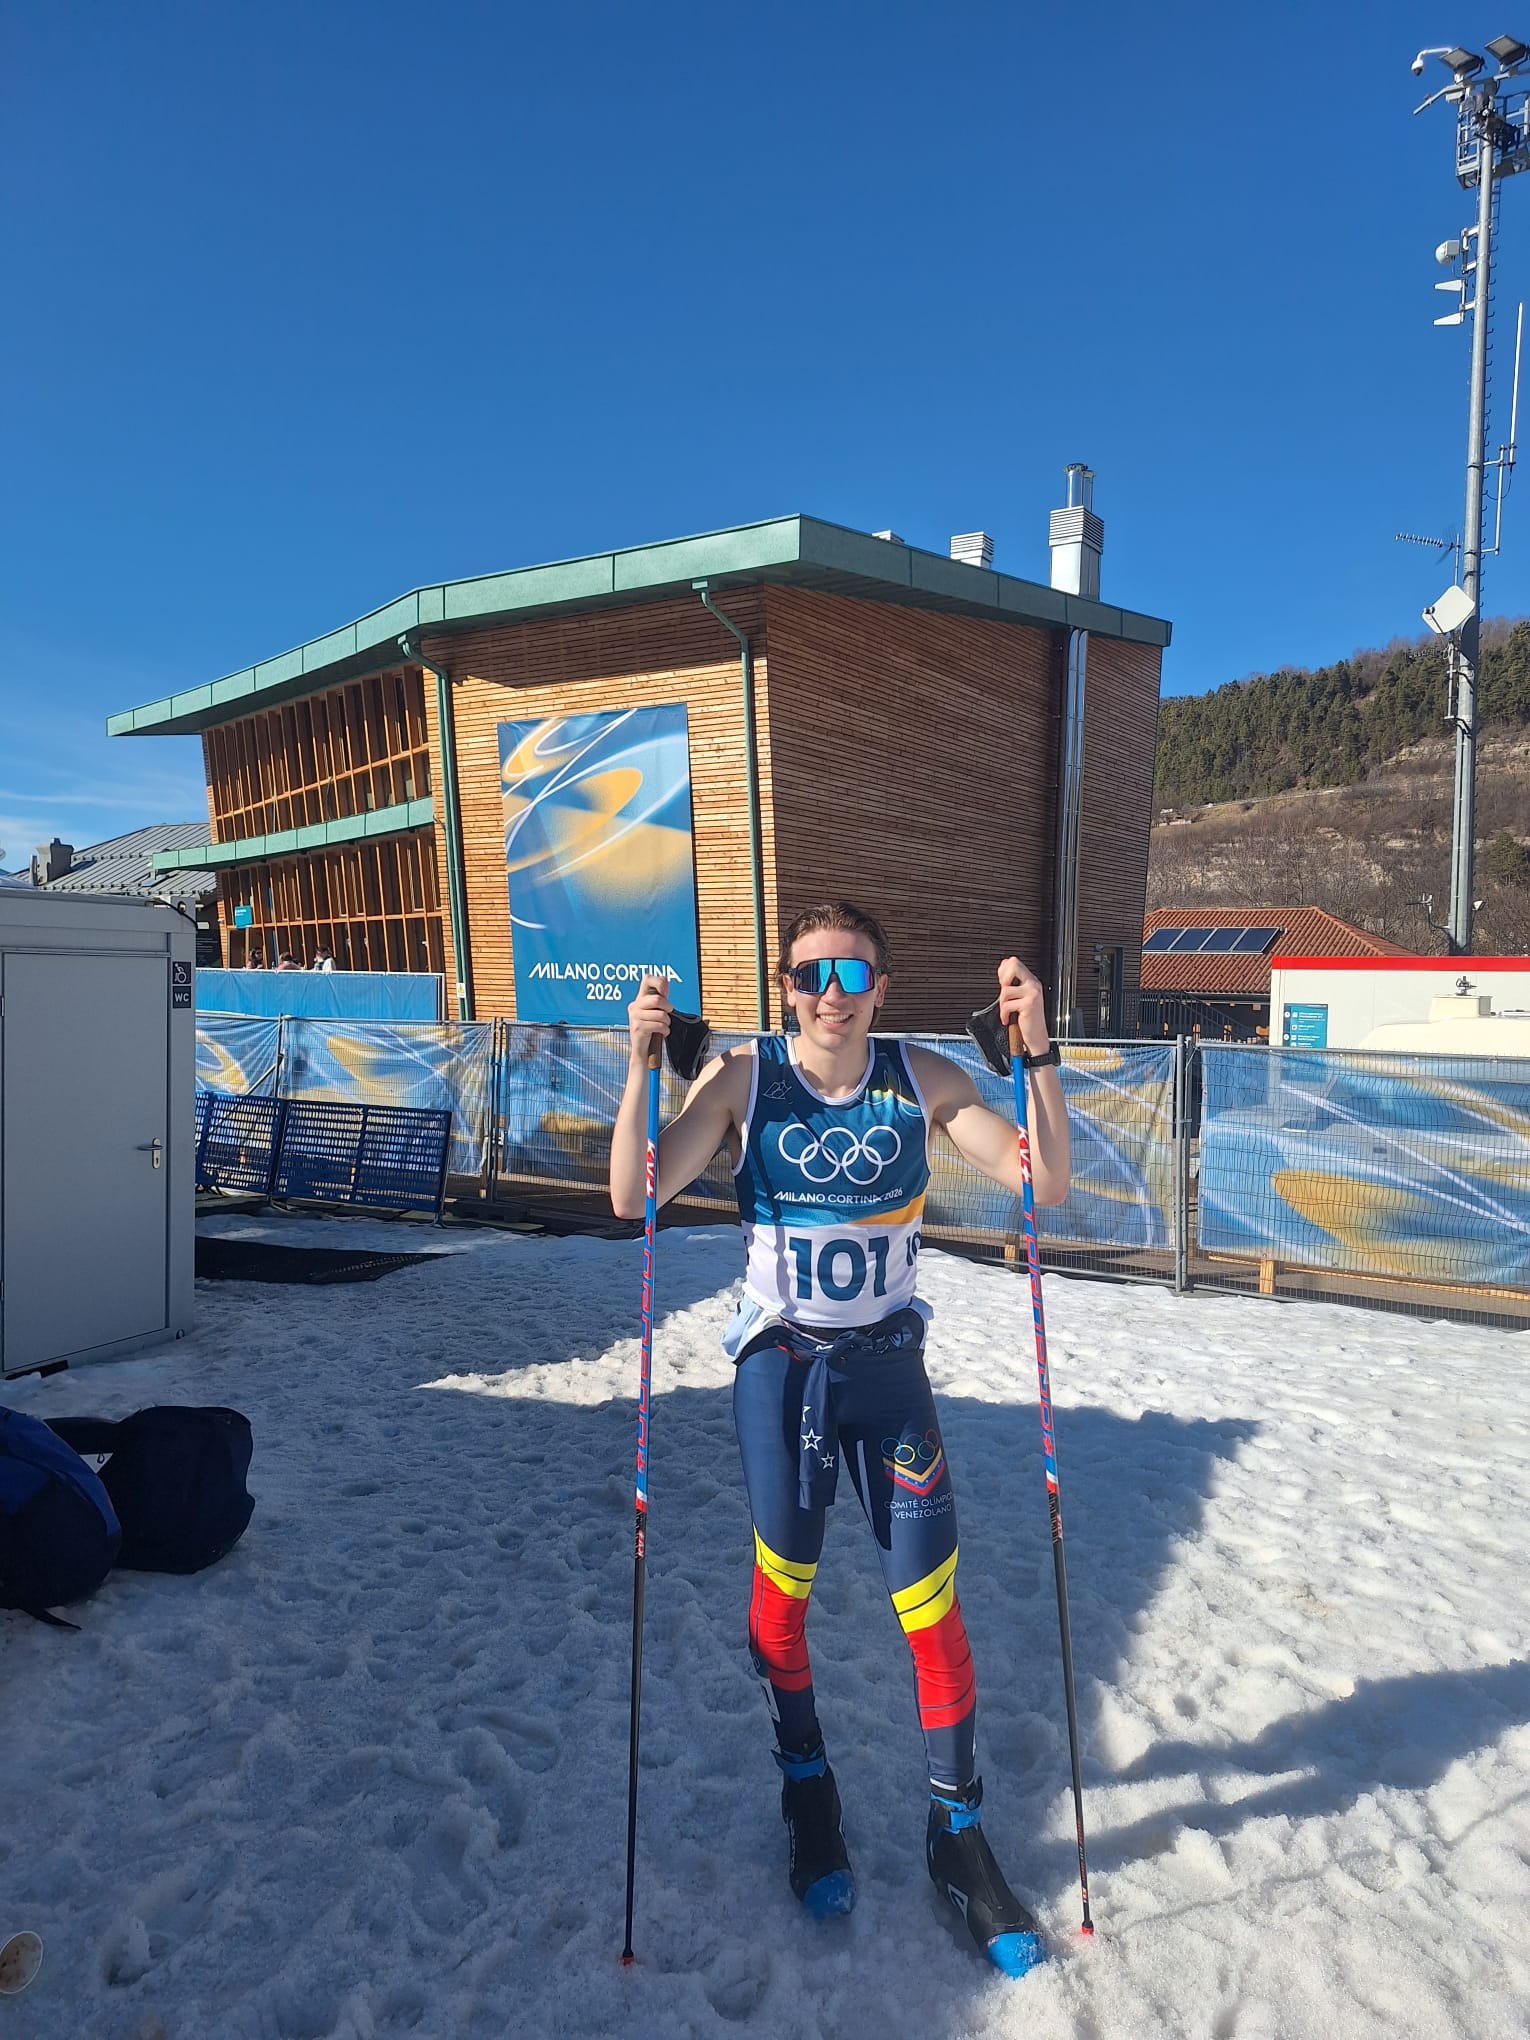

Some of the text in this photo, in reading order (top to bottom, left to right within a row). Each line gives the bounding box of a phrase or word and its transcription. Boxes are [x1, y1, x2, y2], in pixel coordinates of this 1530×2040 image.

[528, 962, 683, 983] MILANO CORTINA
[174, 993, 189, 1002] WC
[586, 983, 622, 1000] 2026
[773, 1187, 903, 1205] MILANO CORTINA 2026
[789, 1235, 890, 1302] 101
[884, 1498, 919, 1509] COMITÉ
[894, 1503, 952, 1519] VENEZOLANO
